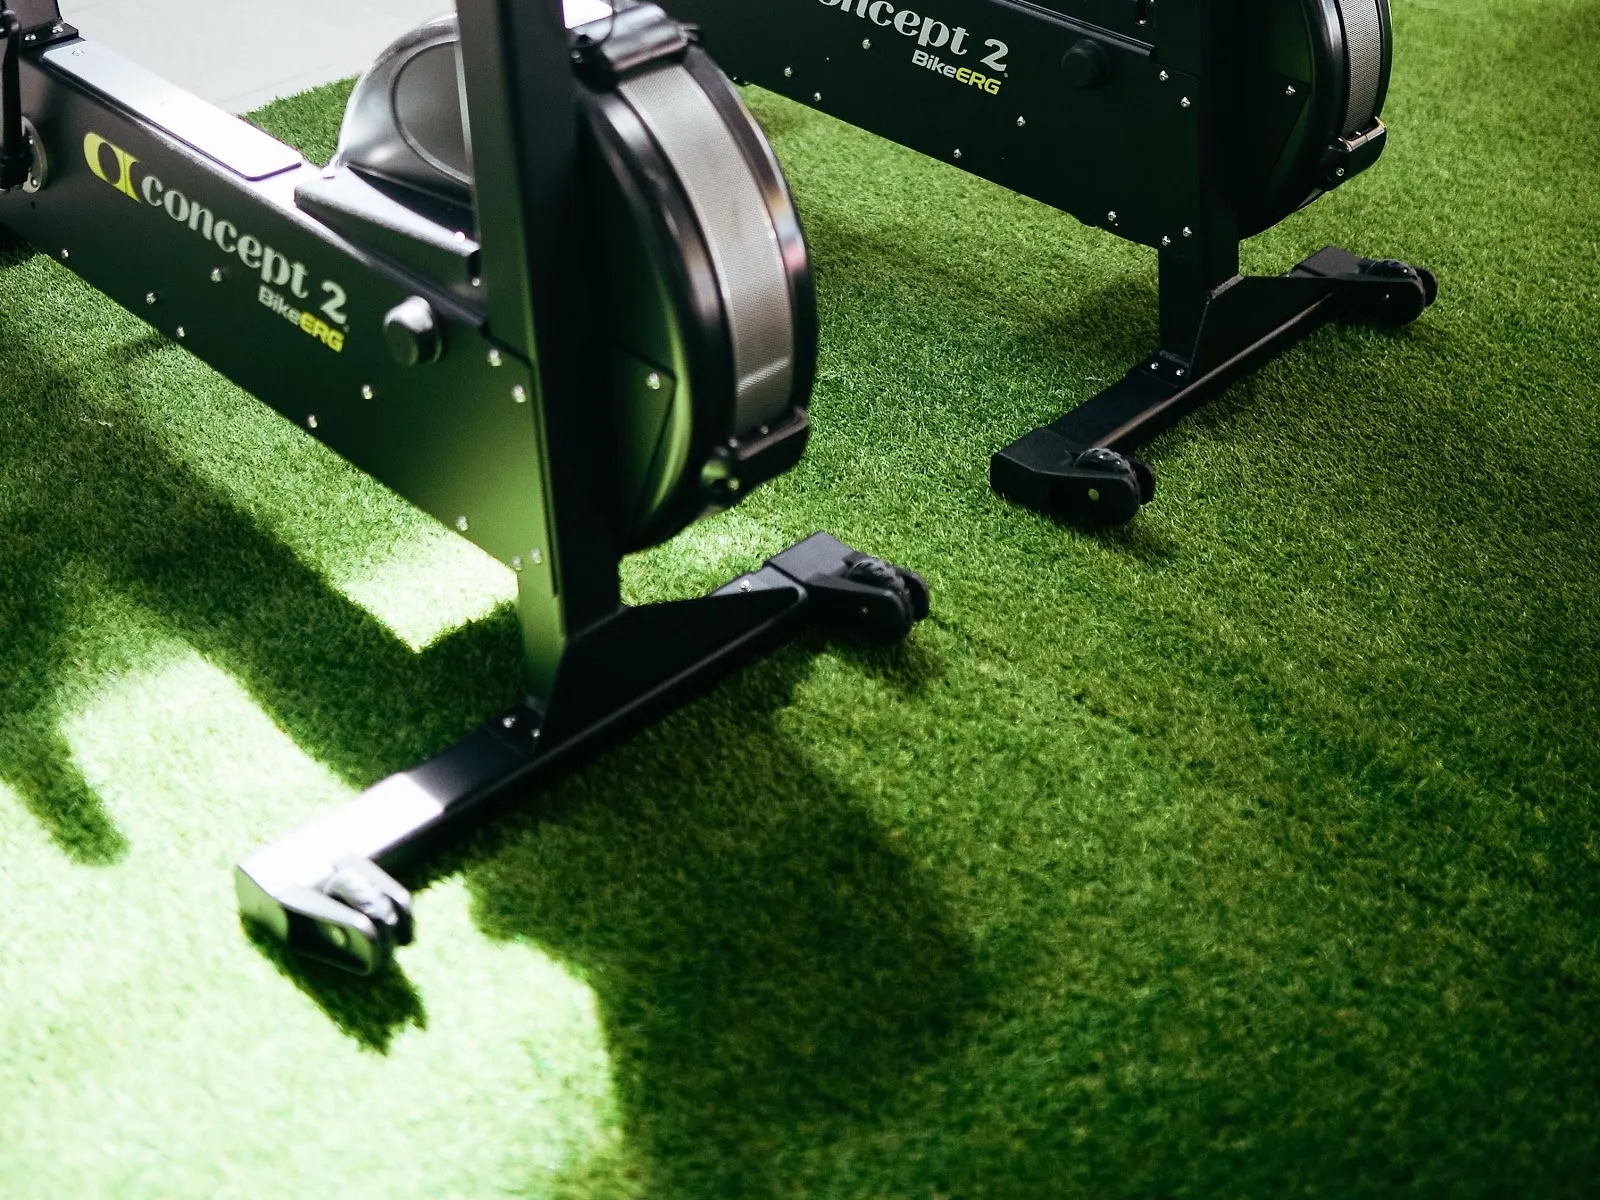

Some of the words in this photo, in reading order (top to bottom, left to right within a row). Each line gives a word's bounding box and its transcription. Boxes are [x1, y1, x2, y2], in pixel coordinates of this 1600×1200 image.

[911, 49, 1002, 95] BikeERG
[980, 38, 1009, 72] 2
[141, 176, 309, 299] concept
[320, 279, 347, 325] 2
[258, 285, 345, 353] BikeERG
